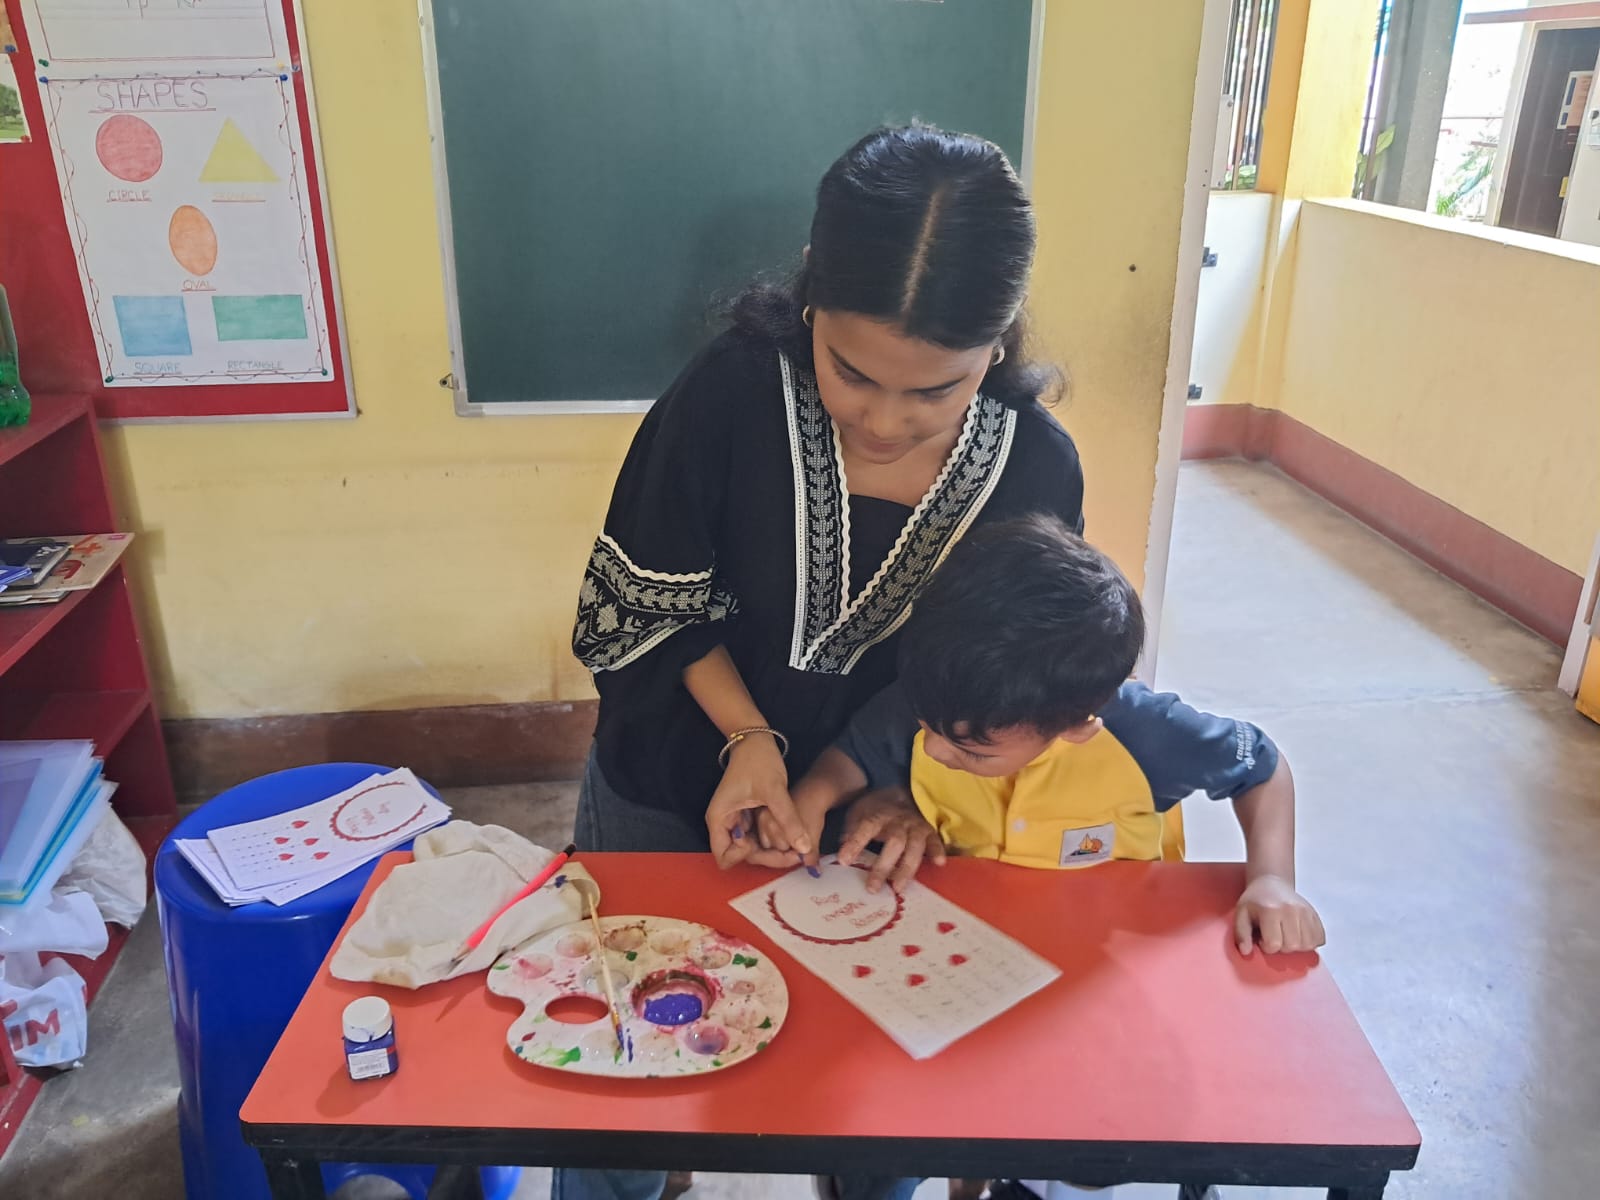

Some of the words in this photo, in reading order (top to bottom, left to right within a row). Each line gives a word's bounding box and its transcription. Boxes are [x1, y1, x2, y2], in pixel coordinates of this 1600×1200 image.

[97, 80, 208, 109] SHAPES
[109, 189, 152, 200] CIRCLE
[134, 361, 181, 373] SQUARE
[227, 360, 282, 370] RECTANGLE
